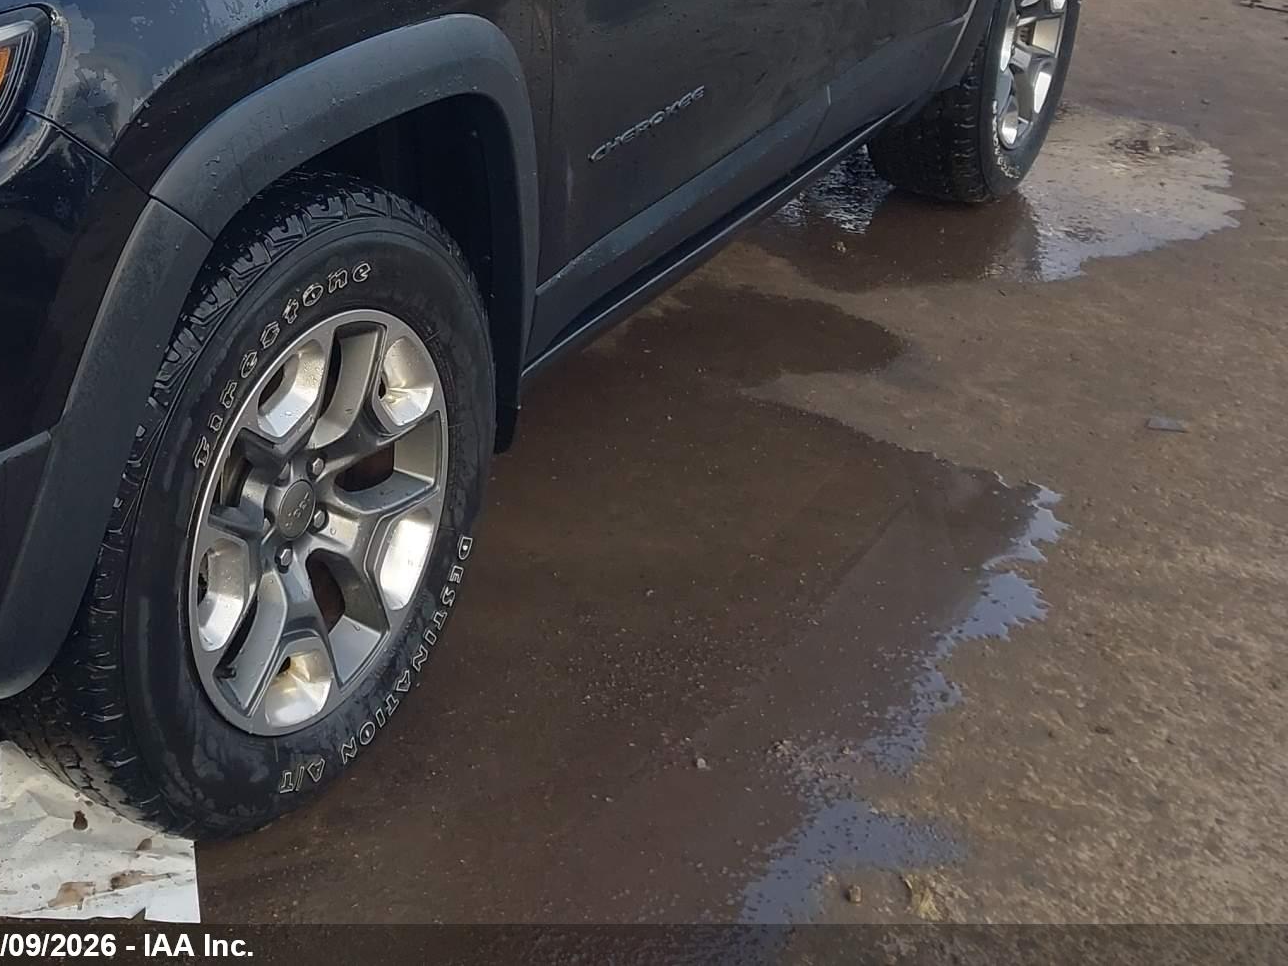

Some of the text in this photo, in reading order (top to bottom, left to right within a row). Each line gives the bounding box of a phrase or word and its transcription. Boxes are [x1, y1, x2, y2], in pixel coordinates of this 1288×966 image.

[588, 84, 705, 162] CHEROKEE
[192, 262, 372, 469] Firestone
[279, 536, 473, 794] DESTINATION A/T
